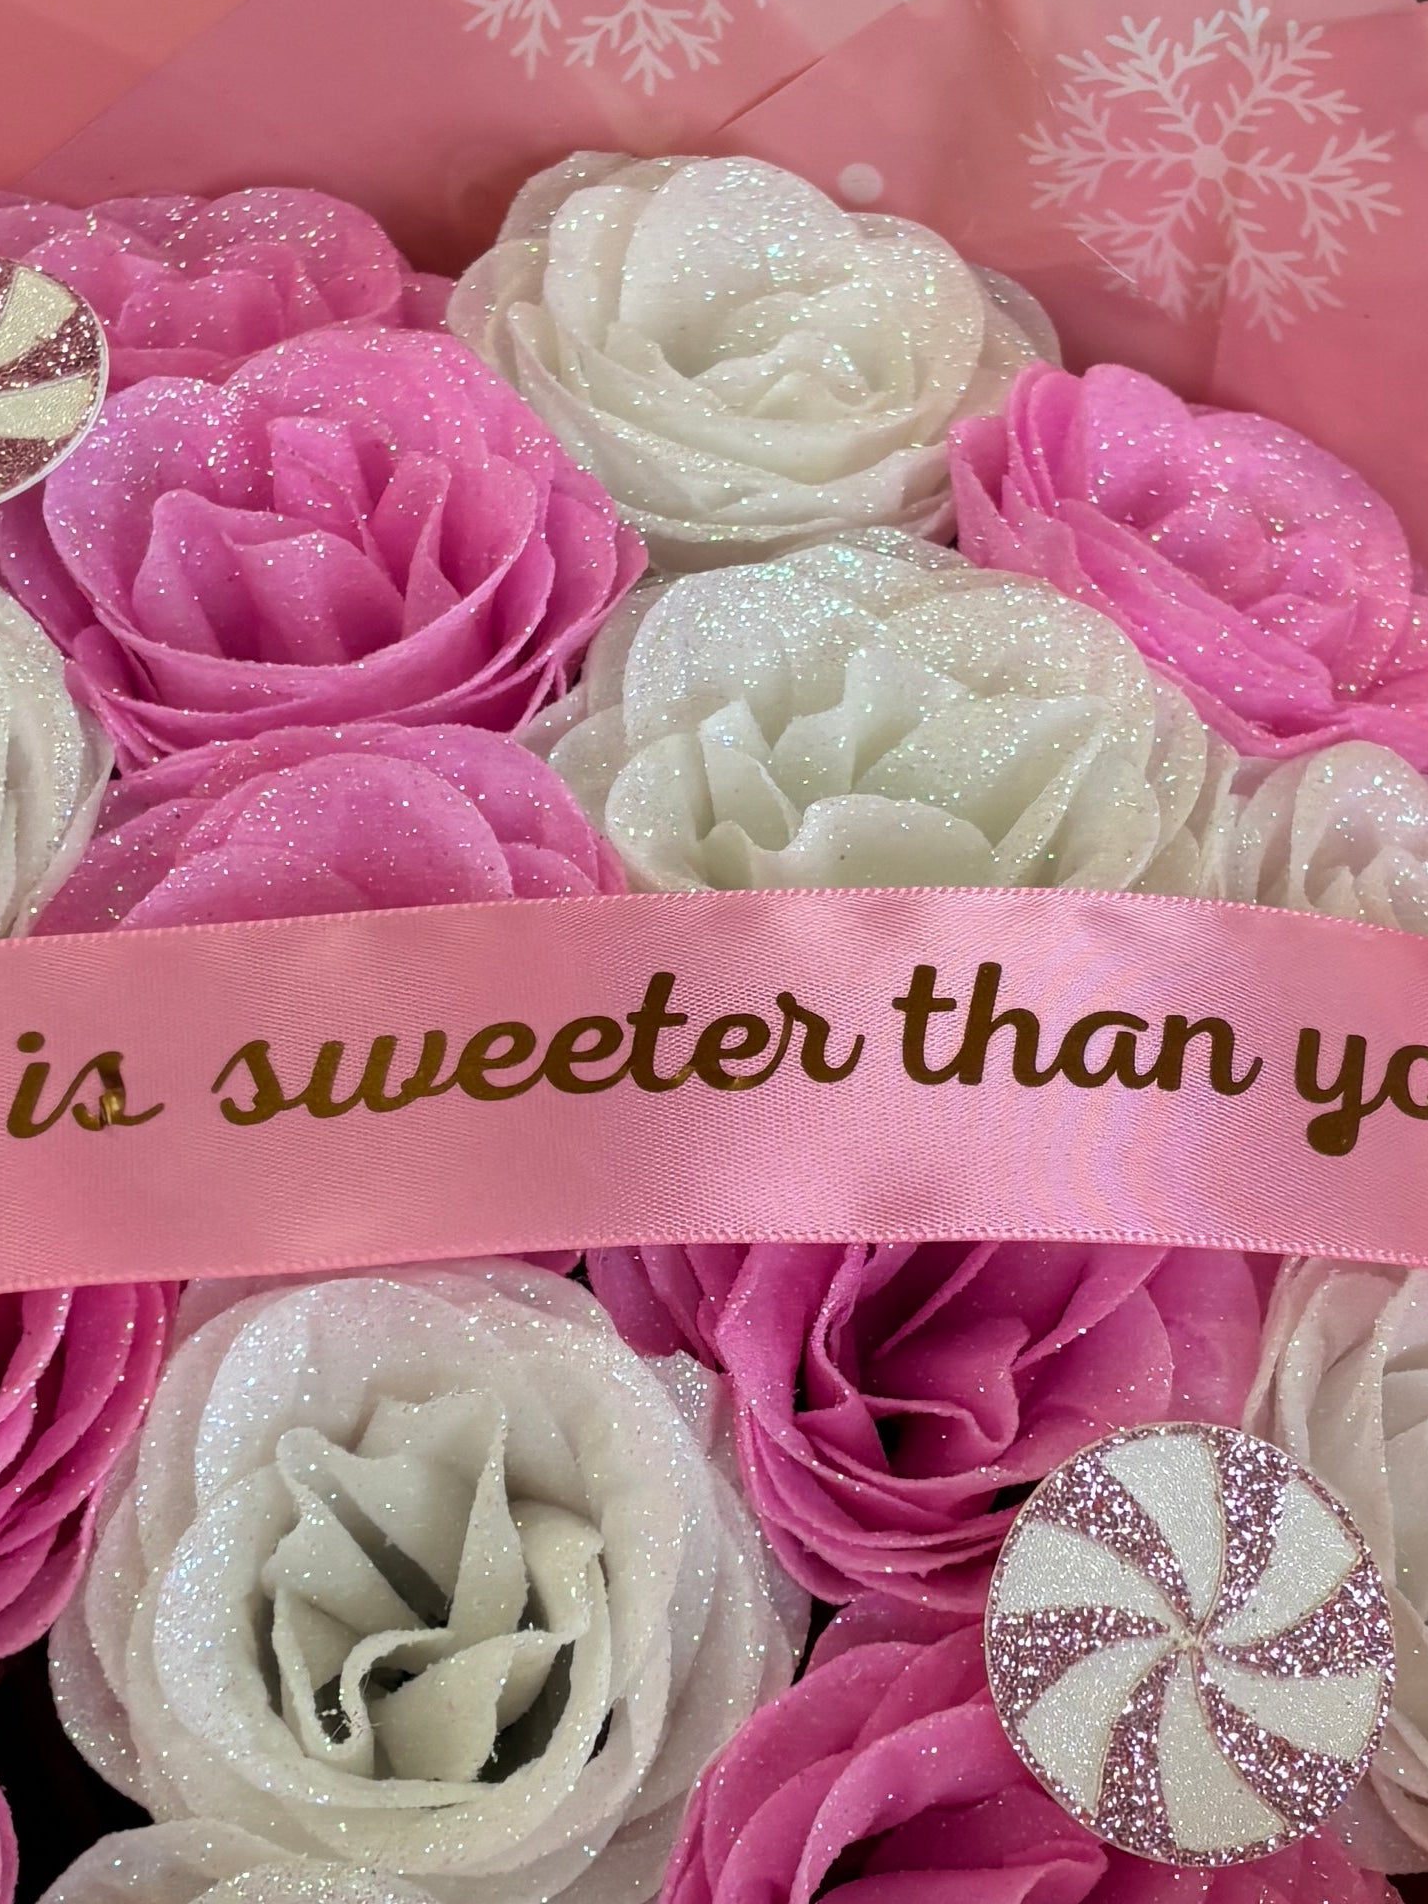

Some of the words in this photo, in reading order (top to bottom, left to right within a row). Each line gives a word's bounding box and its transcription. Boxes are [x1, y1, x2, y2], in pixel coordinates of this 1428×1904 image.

[4, 1030, 165, 1140] is
[210, 970, 866, 1127] sweeter
[891, 960, 1265, 1094] than
